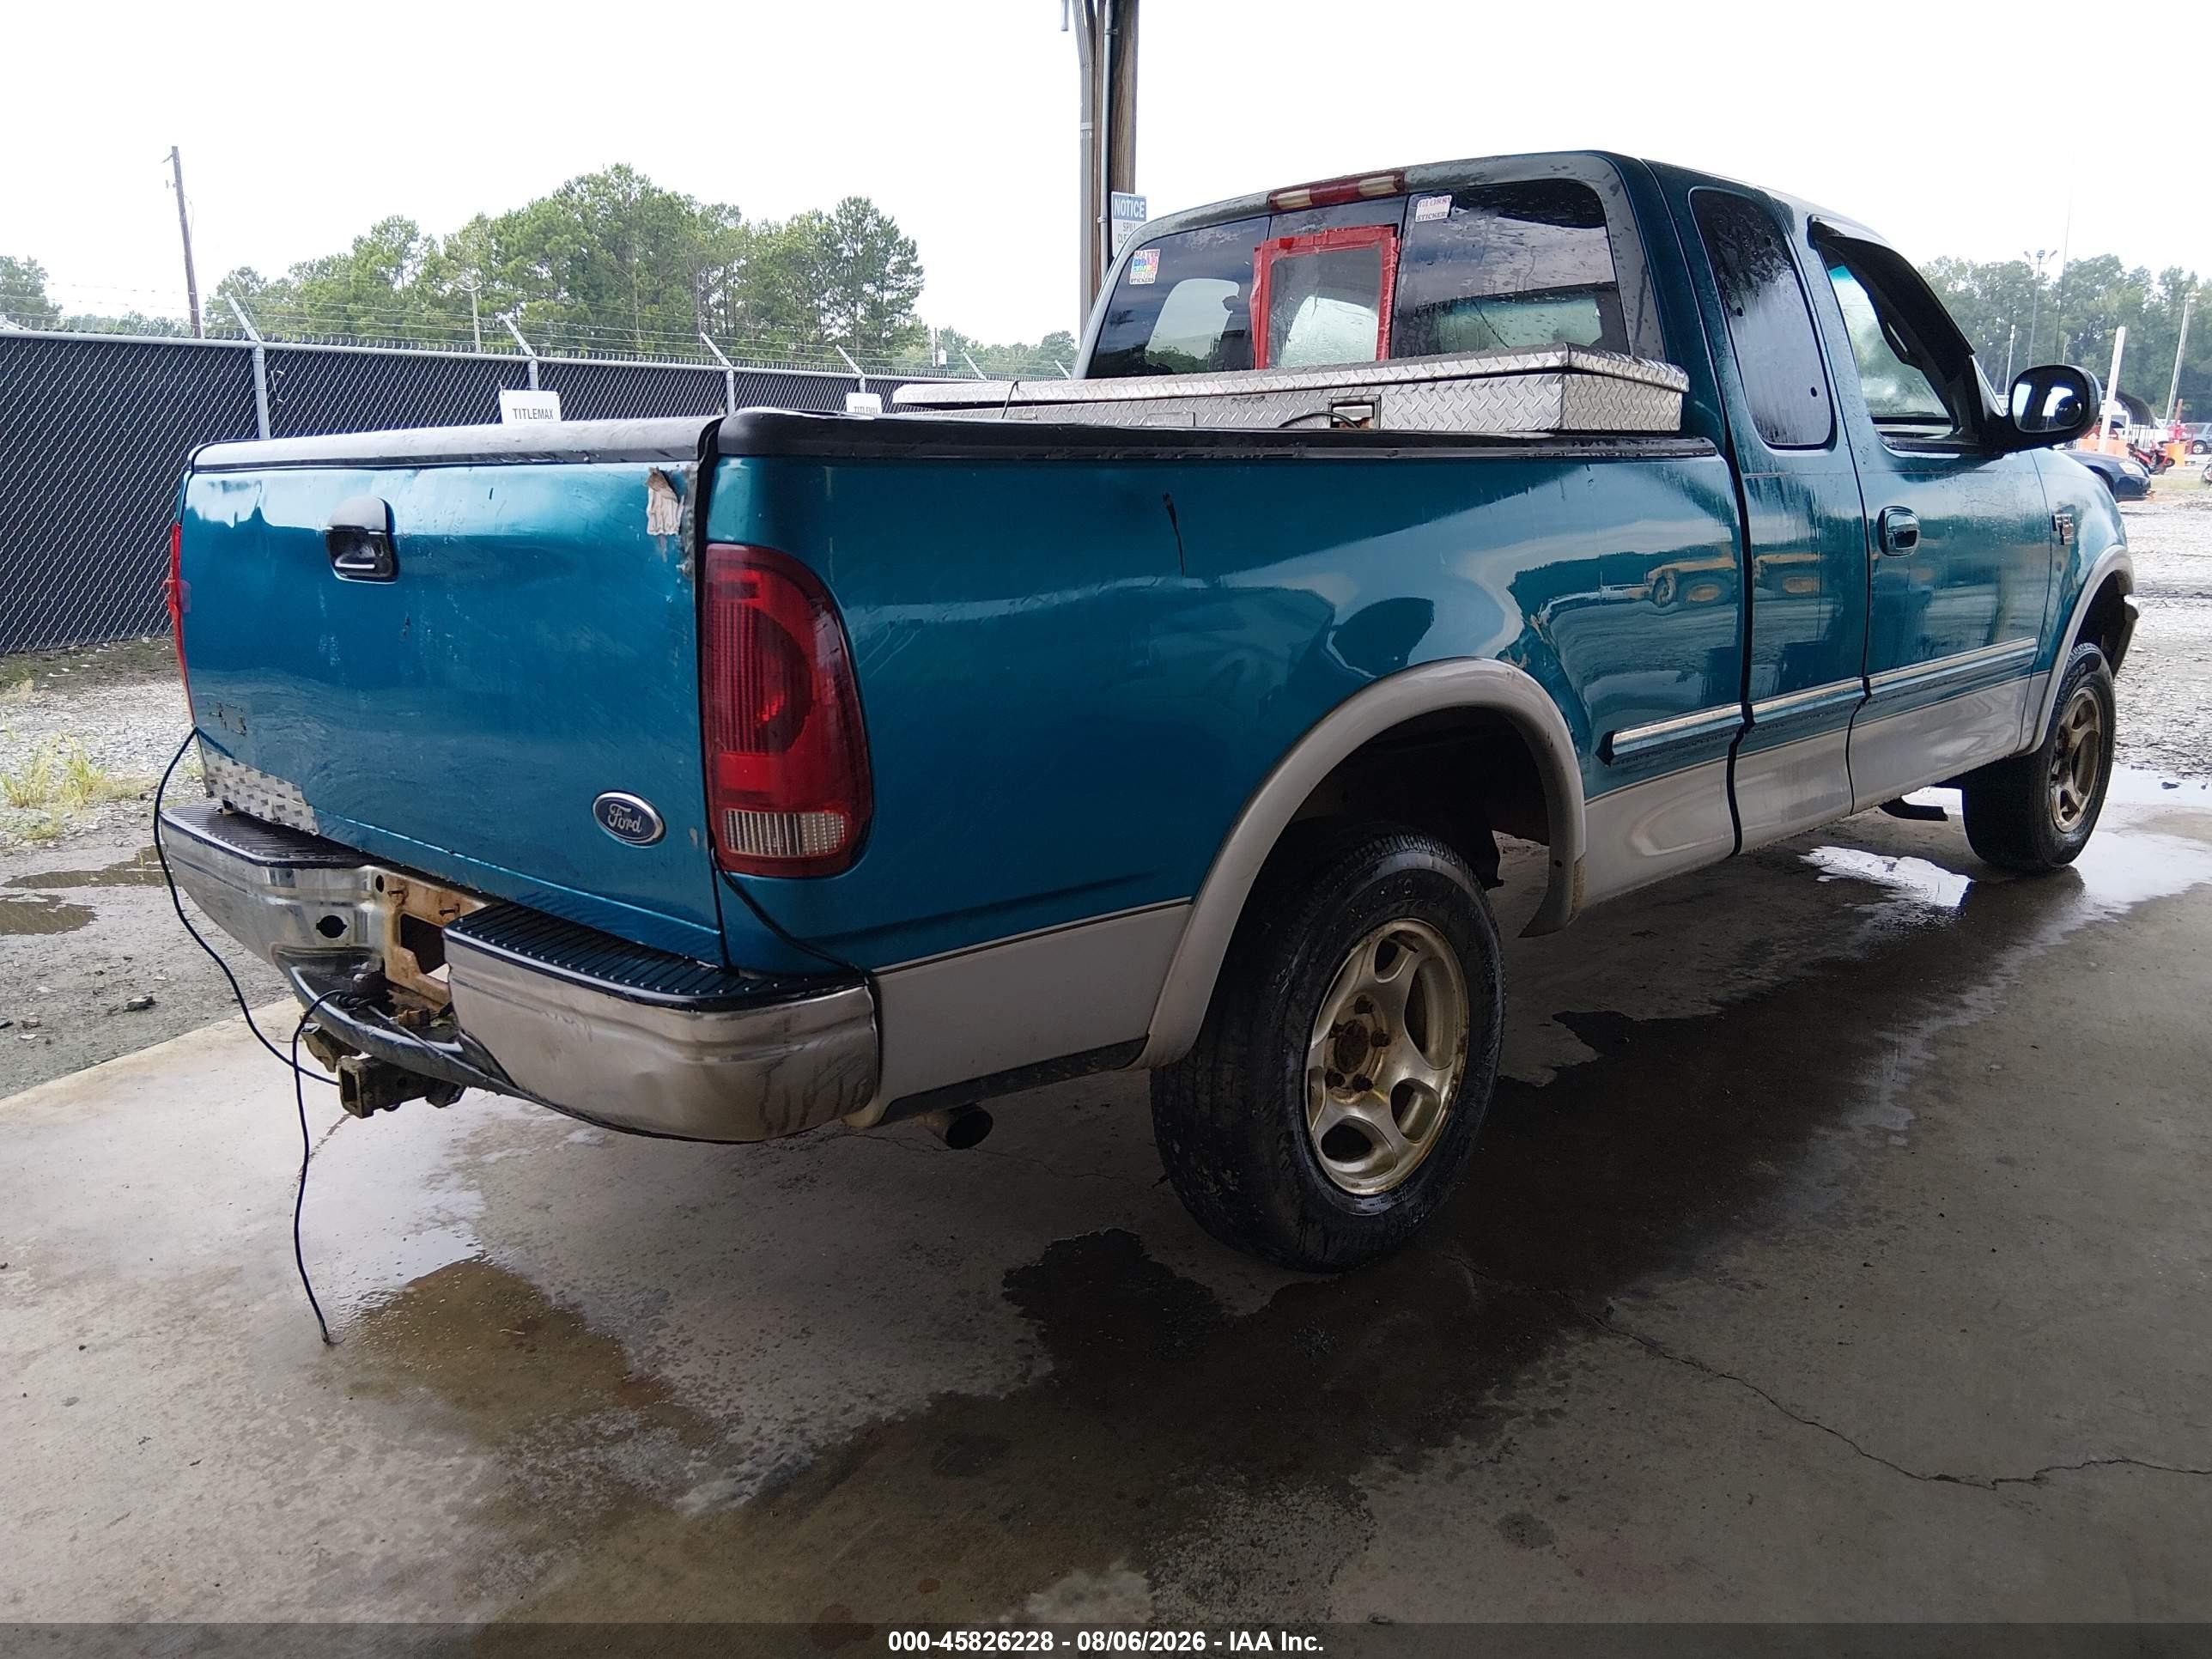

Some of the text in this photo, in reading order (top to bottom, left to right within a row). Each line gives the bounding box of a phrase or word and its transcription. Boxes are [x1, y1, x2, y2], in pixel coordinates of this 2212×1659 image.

[1114, 198, 1146, 218] NOTICE
[512, 408, 554, 420] TITLEMAX
[608, 803, 642, 834] Ford
